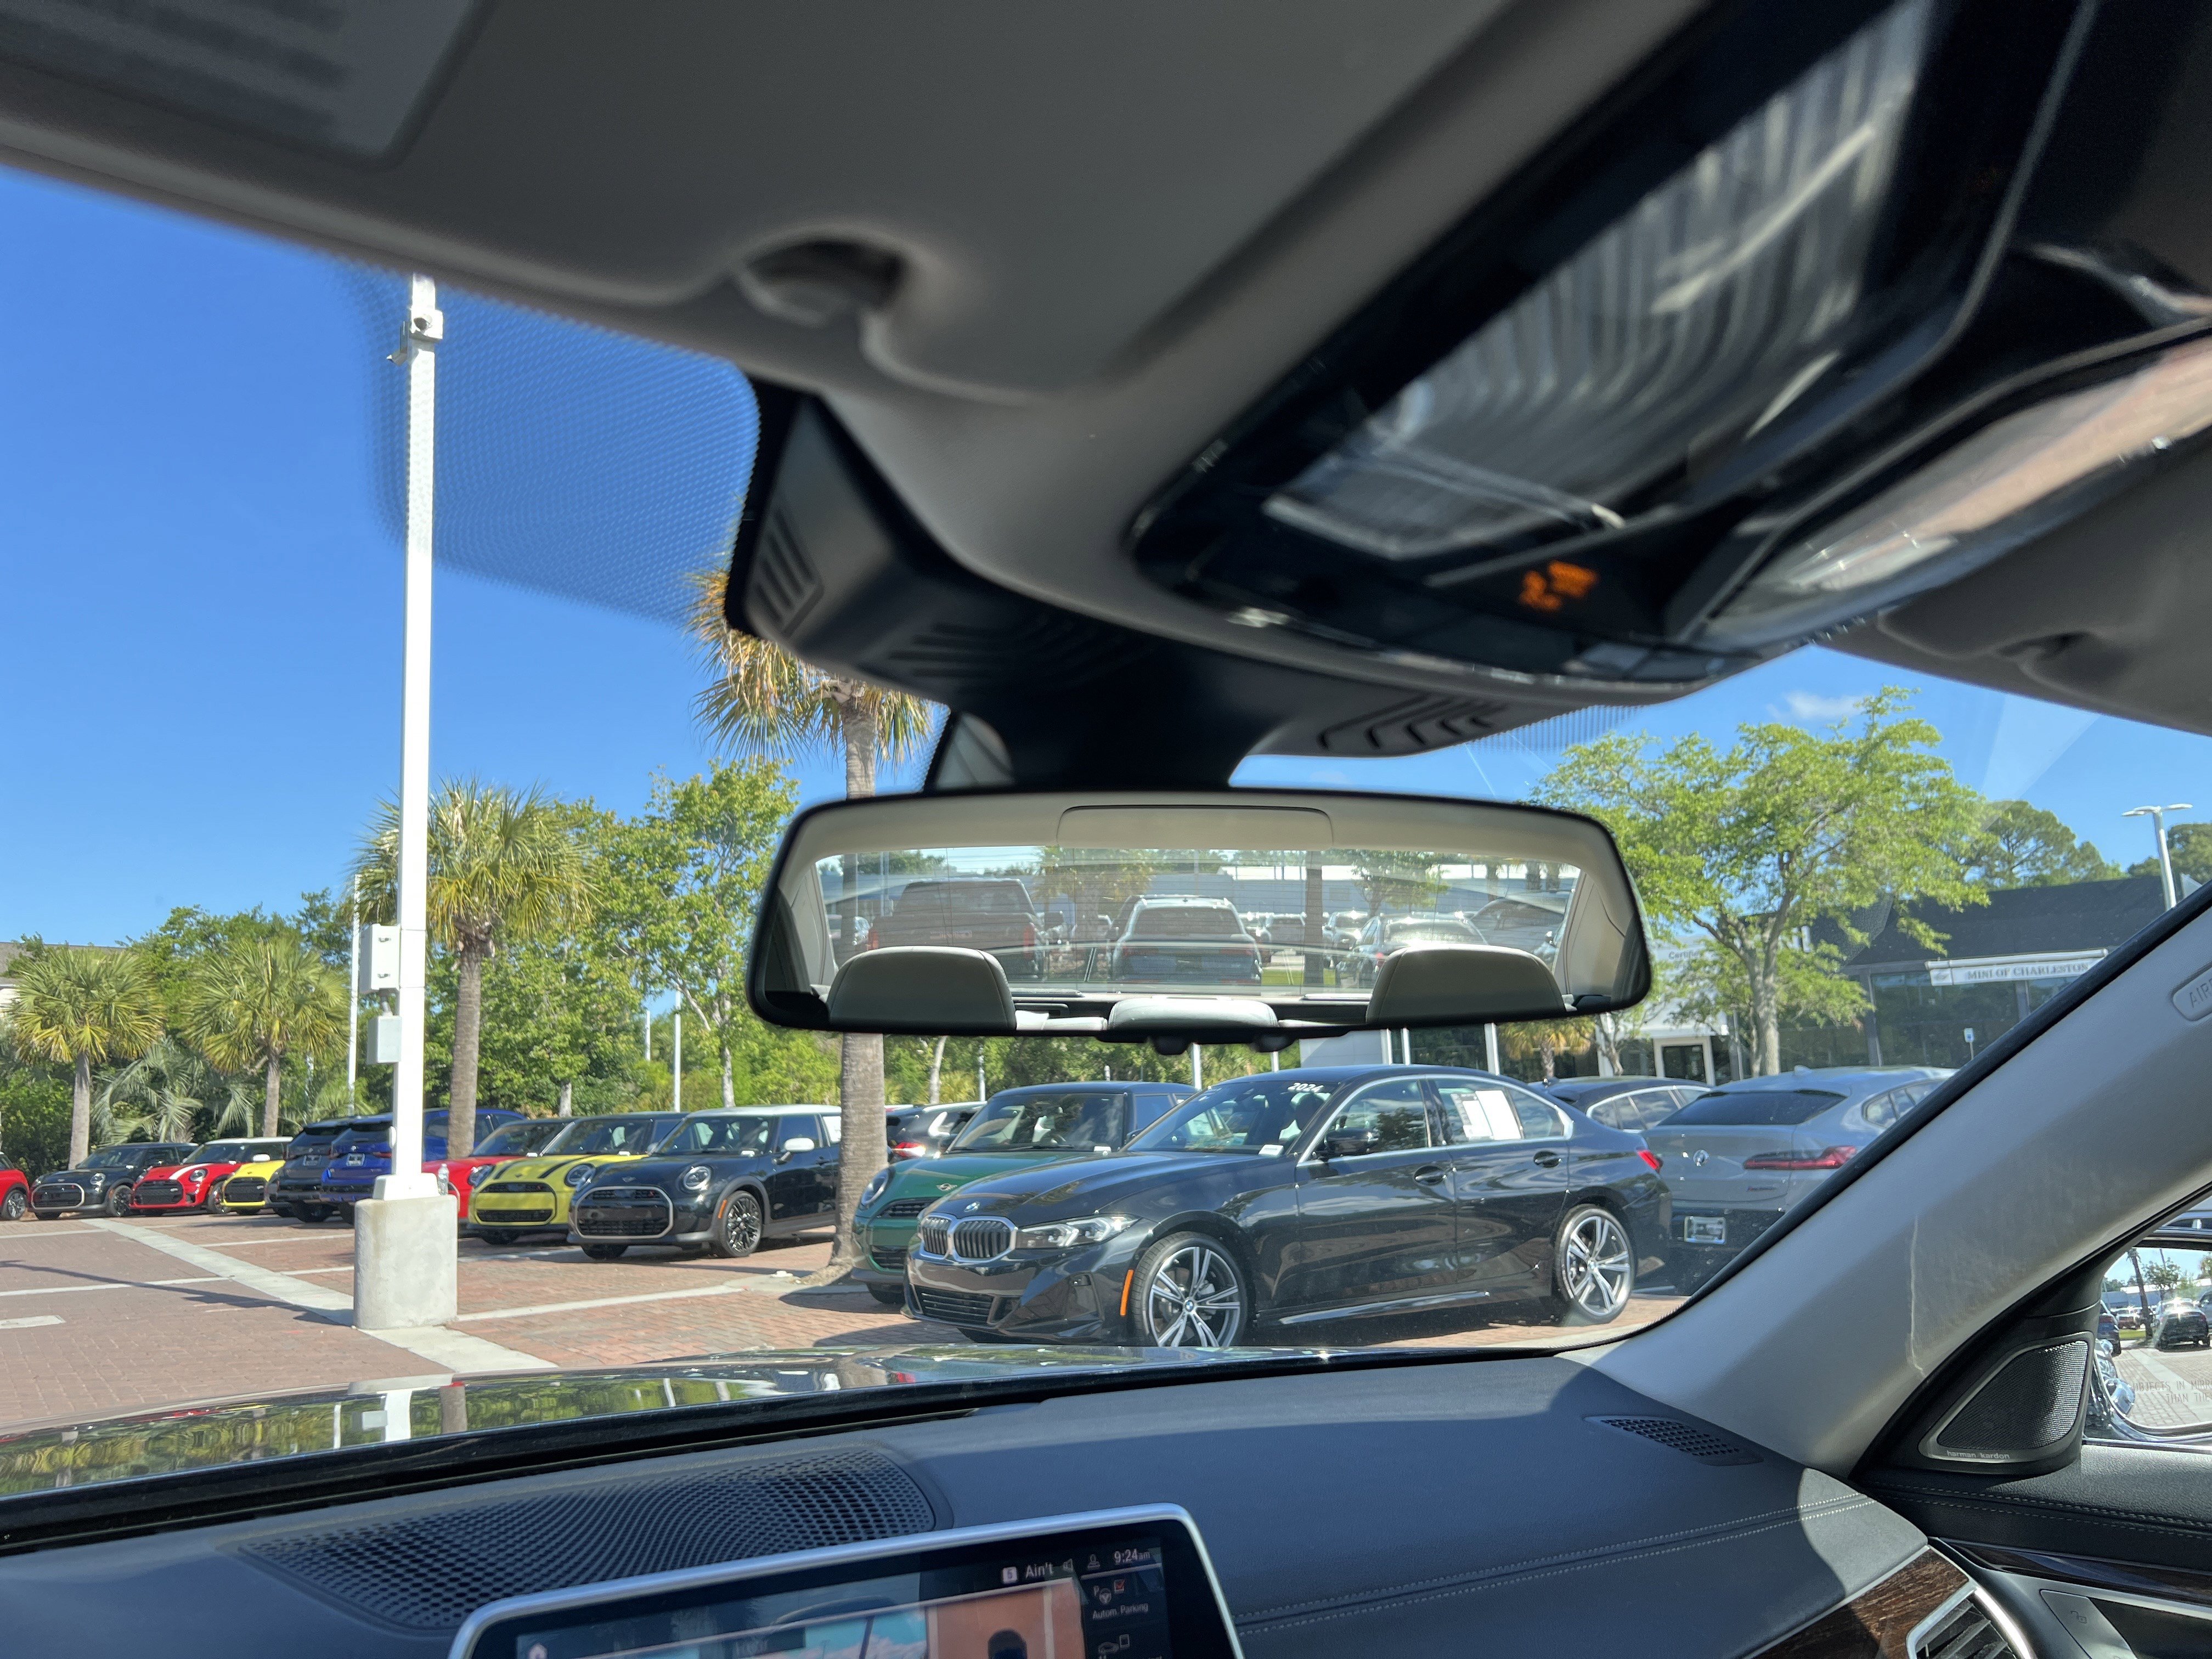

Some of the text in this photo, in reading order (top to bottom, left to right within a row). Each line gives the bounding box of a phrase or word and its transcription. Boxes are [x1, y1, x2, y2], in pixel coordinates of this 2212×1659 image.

[1967, 968, 1993, 980] MINI
[1995, 967, 2011, 978] OF
[2176, 1380, 2185, 1390] IN
[2191, 1379, 2212, 1390] MIRR
[2166, 1392, 2189, 1403] THAN
[1946, 1449, 1977, 1458] harman
[1025, 1561, 1054, 1579] Ain't
[1120, 1602, 1149, 1615] Parking
